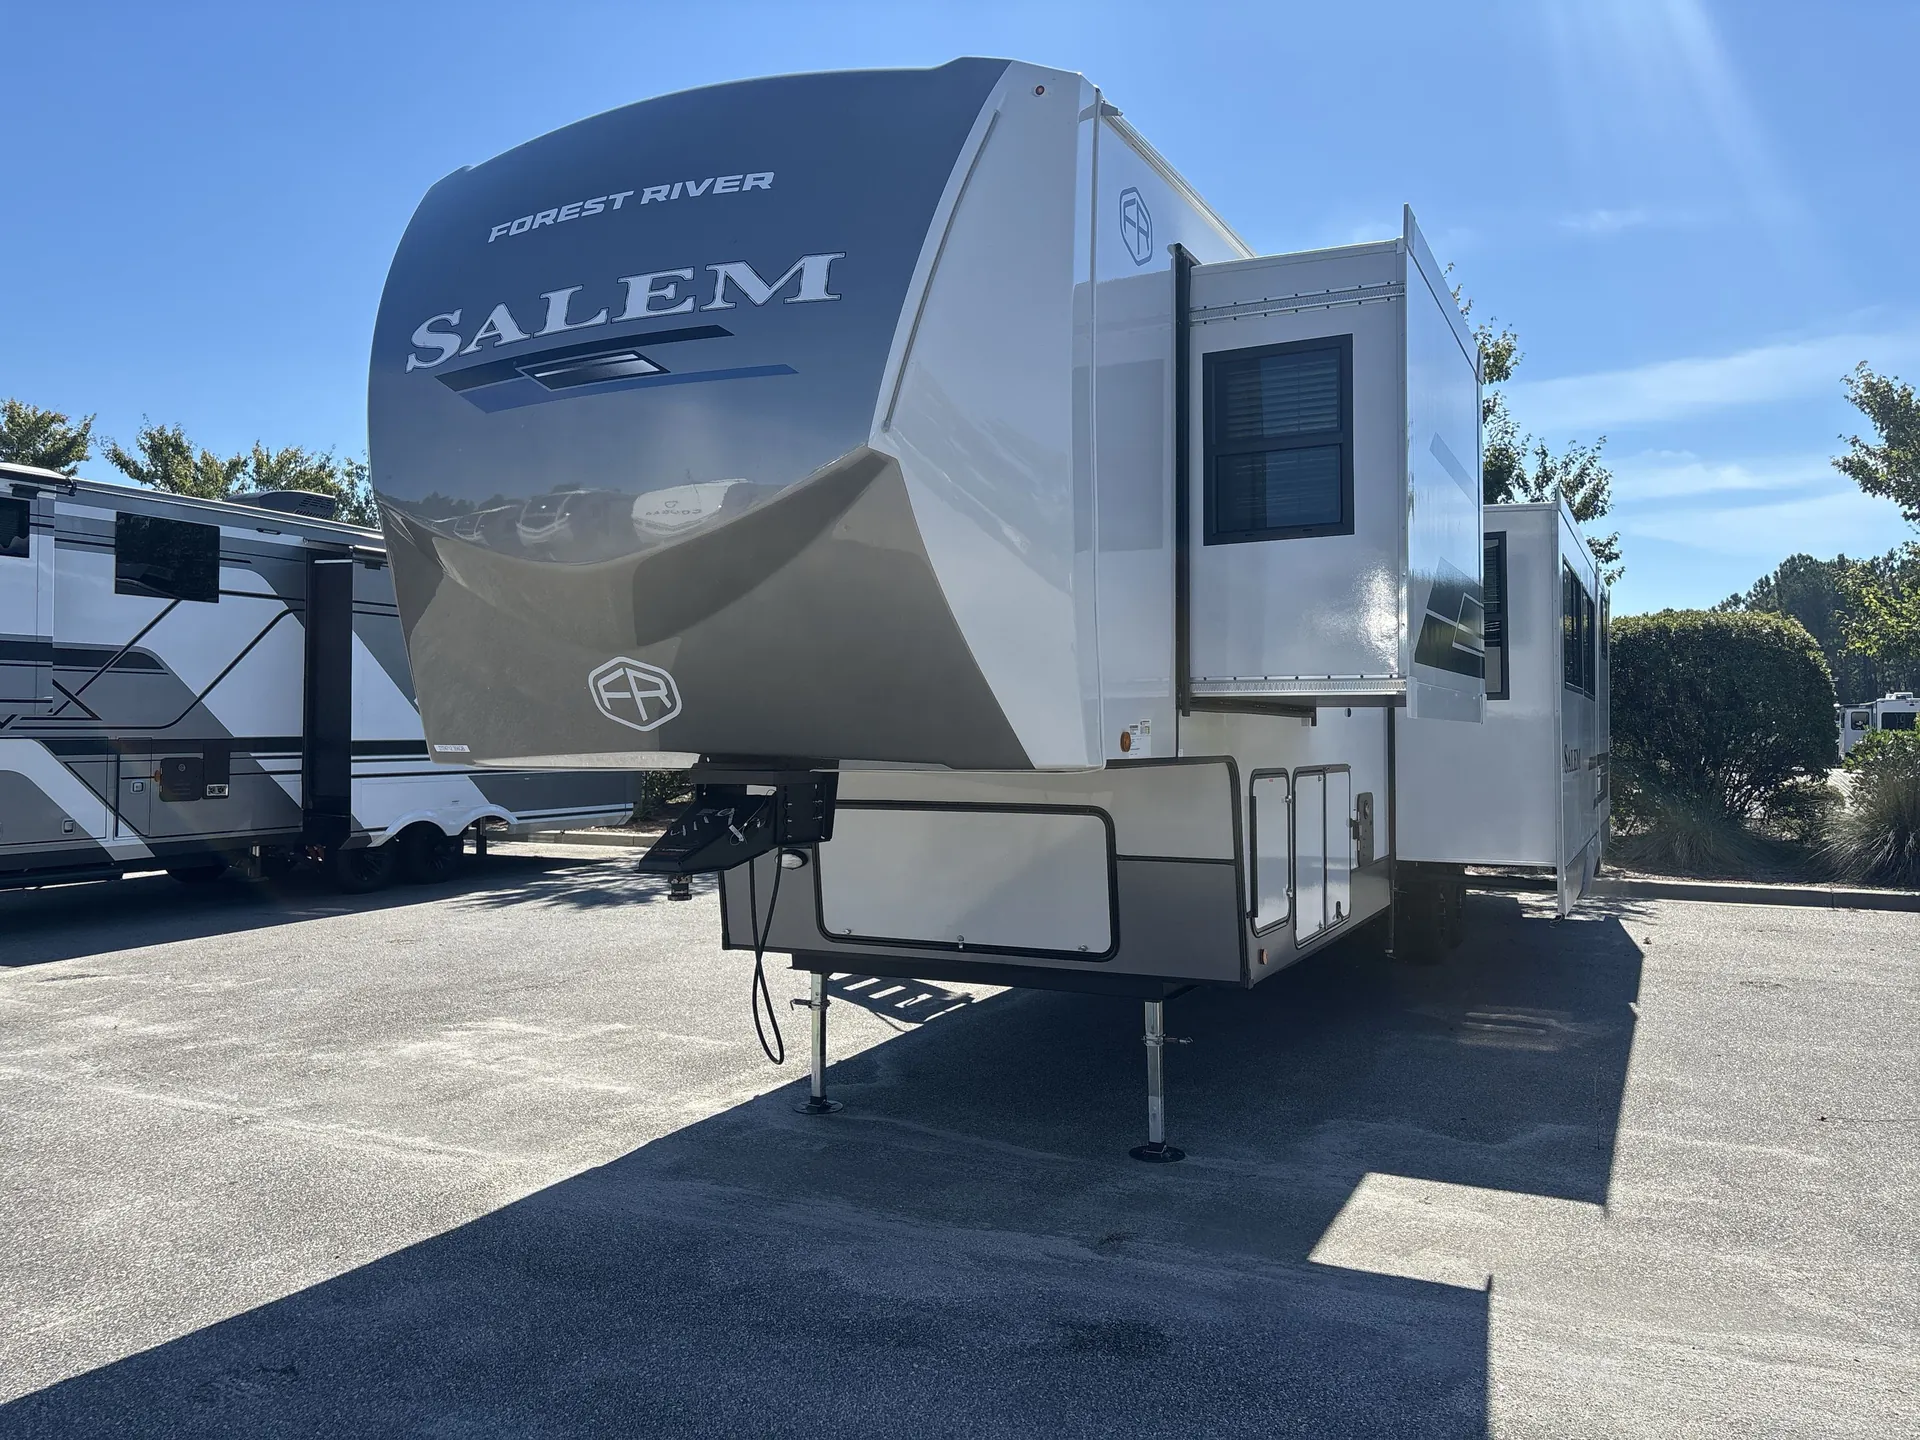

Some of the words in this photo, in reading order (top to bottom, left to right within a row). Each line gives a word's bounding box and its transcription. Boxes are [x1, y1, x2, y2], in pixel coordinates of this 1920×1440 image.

[488, 191, 633, 244] FOREST
[640, 172, 775, 204] RIVER
[404, 251, 847, 374] SALEM
